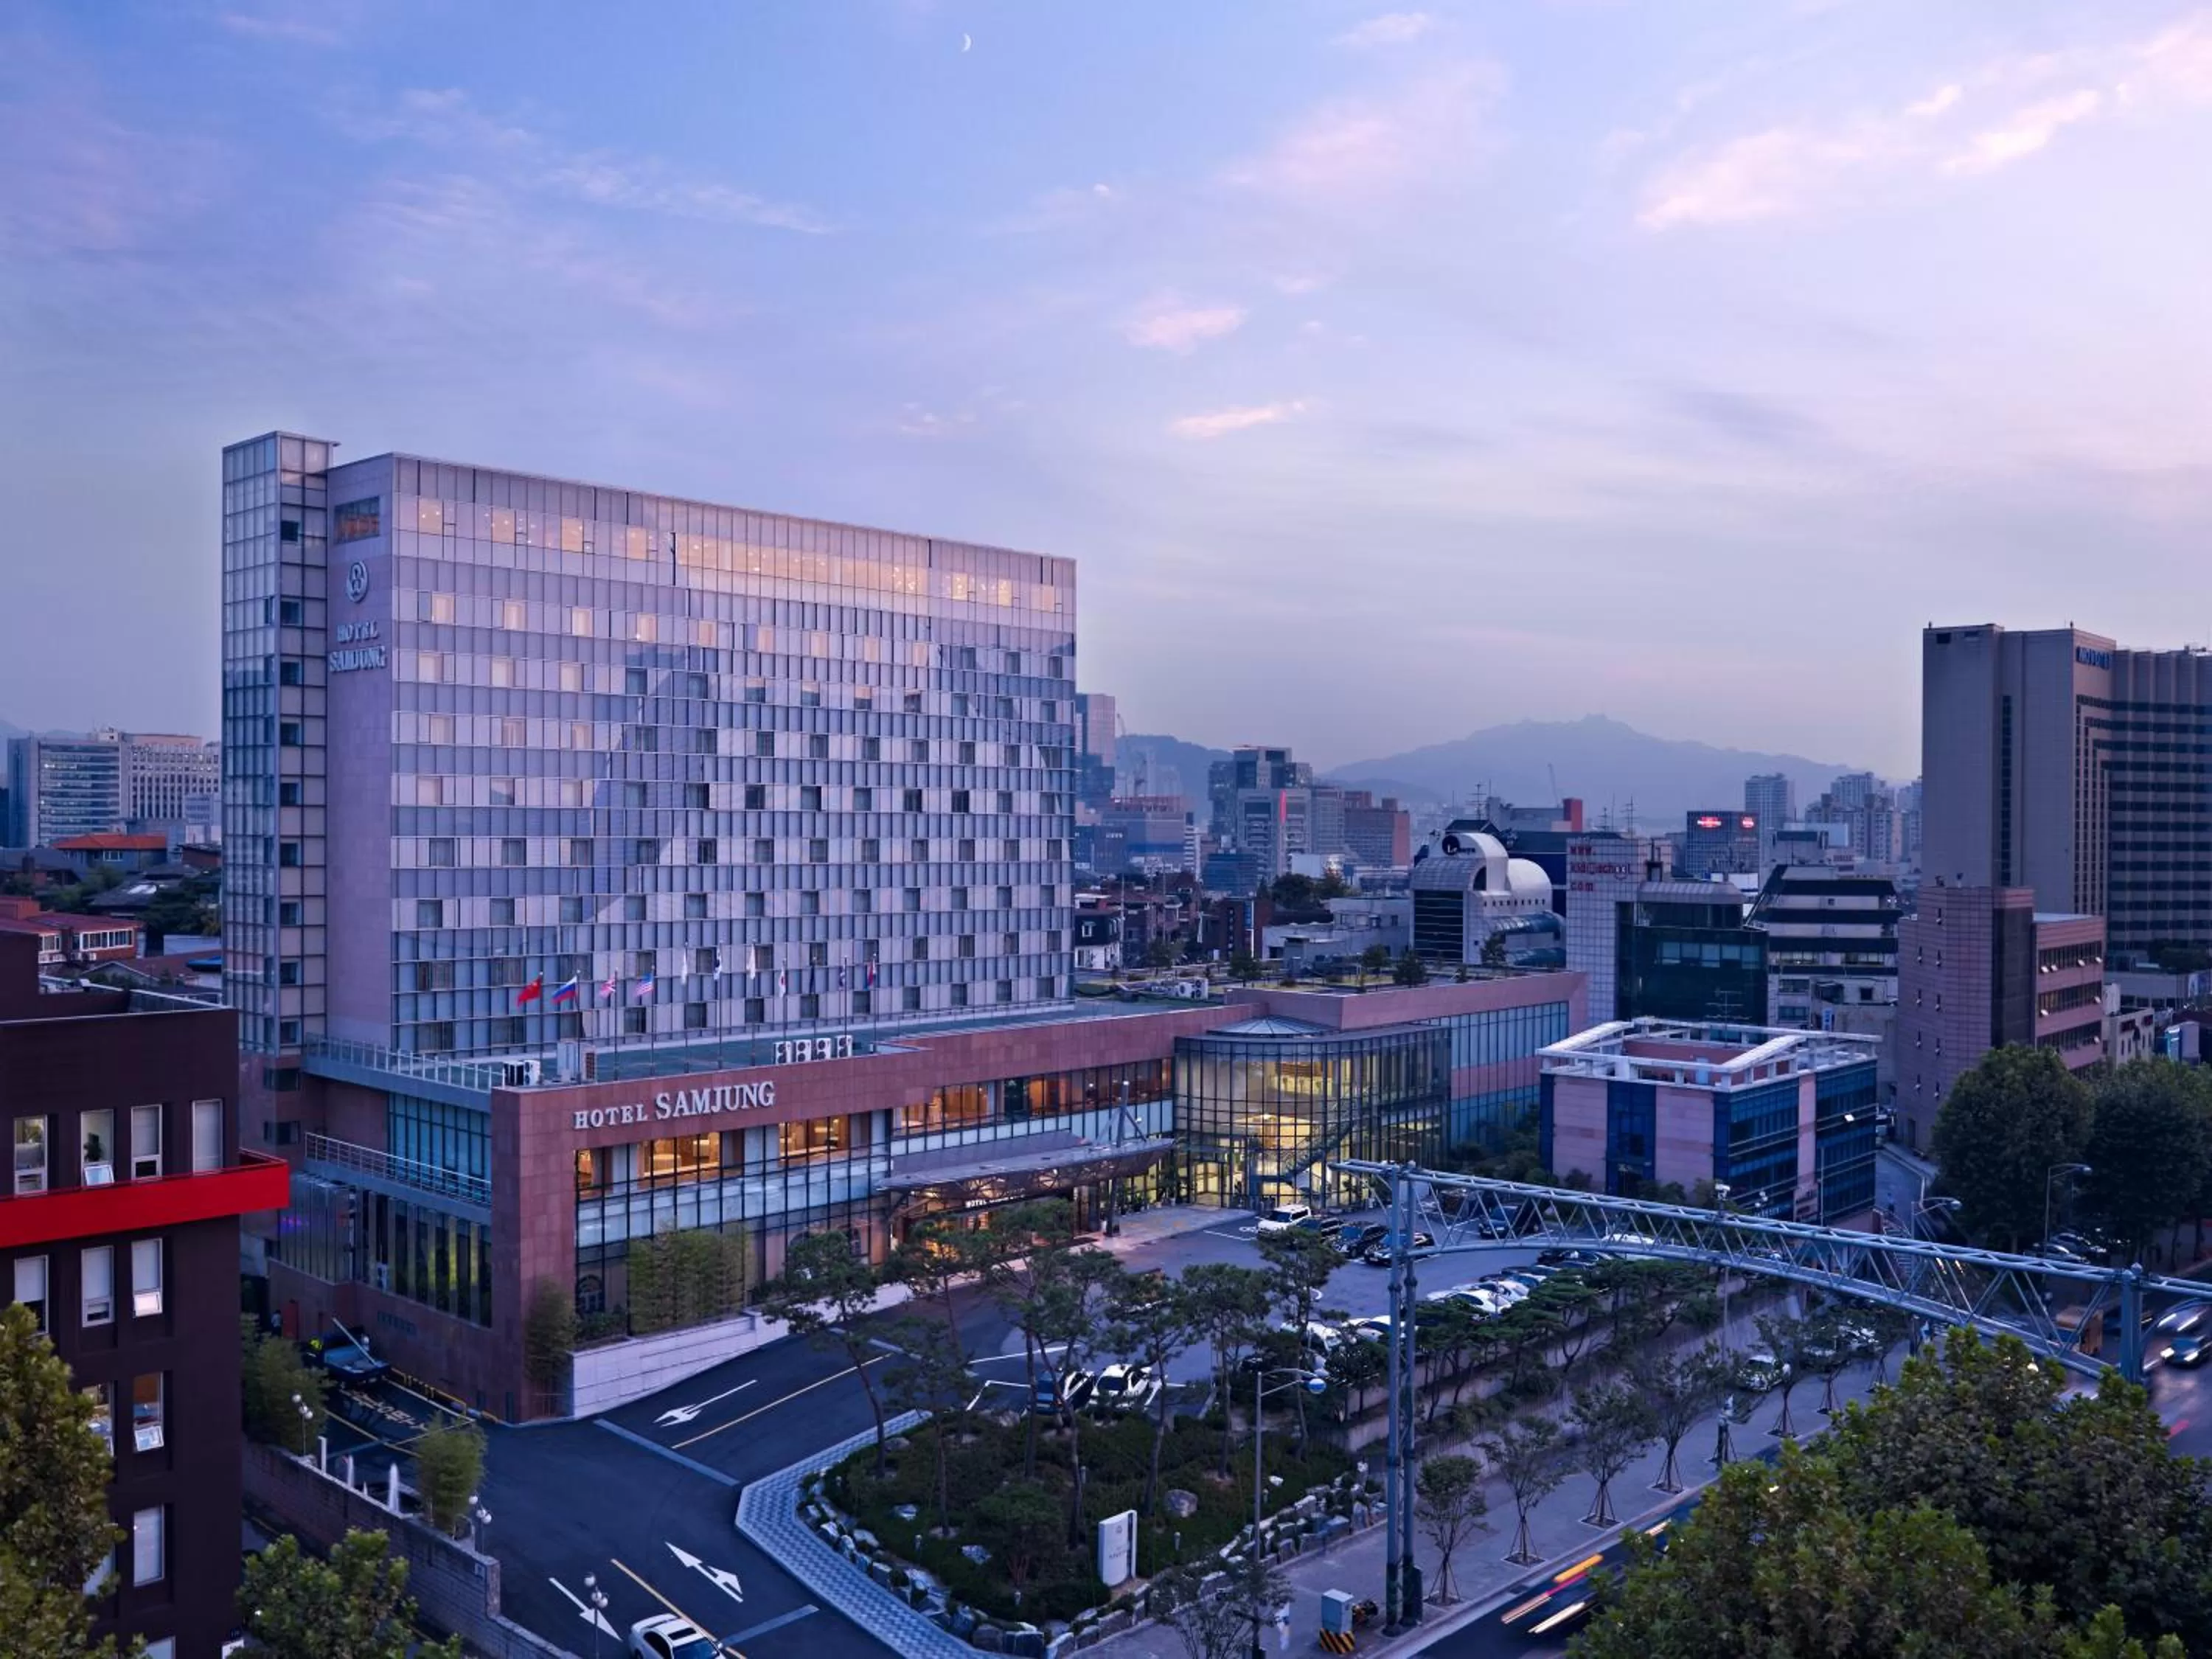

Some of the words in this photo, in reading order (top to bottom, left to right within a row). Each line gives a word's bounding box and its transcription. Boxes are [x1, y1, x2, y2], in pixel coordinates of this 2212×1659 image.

[337, 622, 379, 641] HOTEL
[574, 1104, 648, 1130] HOTEL
[655, 1080, 776, 1121] SAMJUNG
